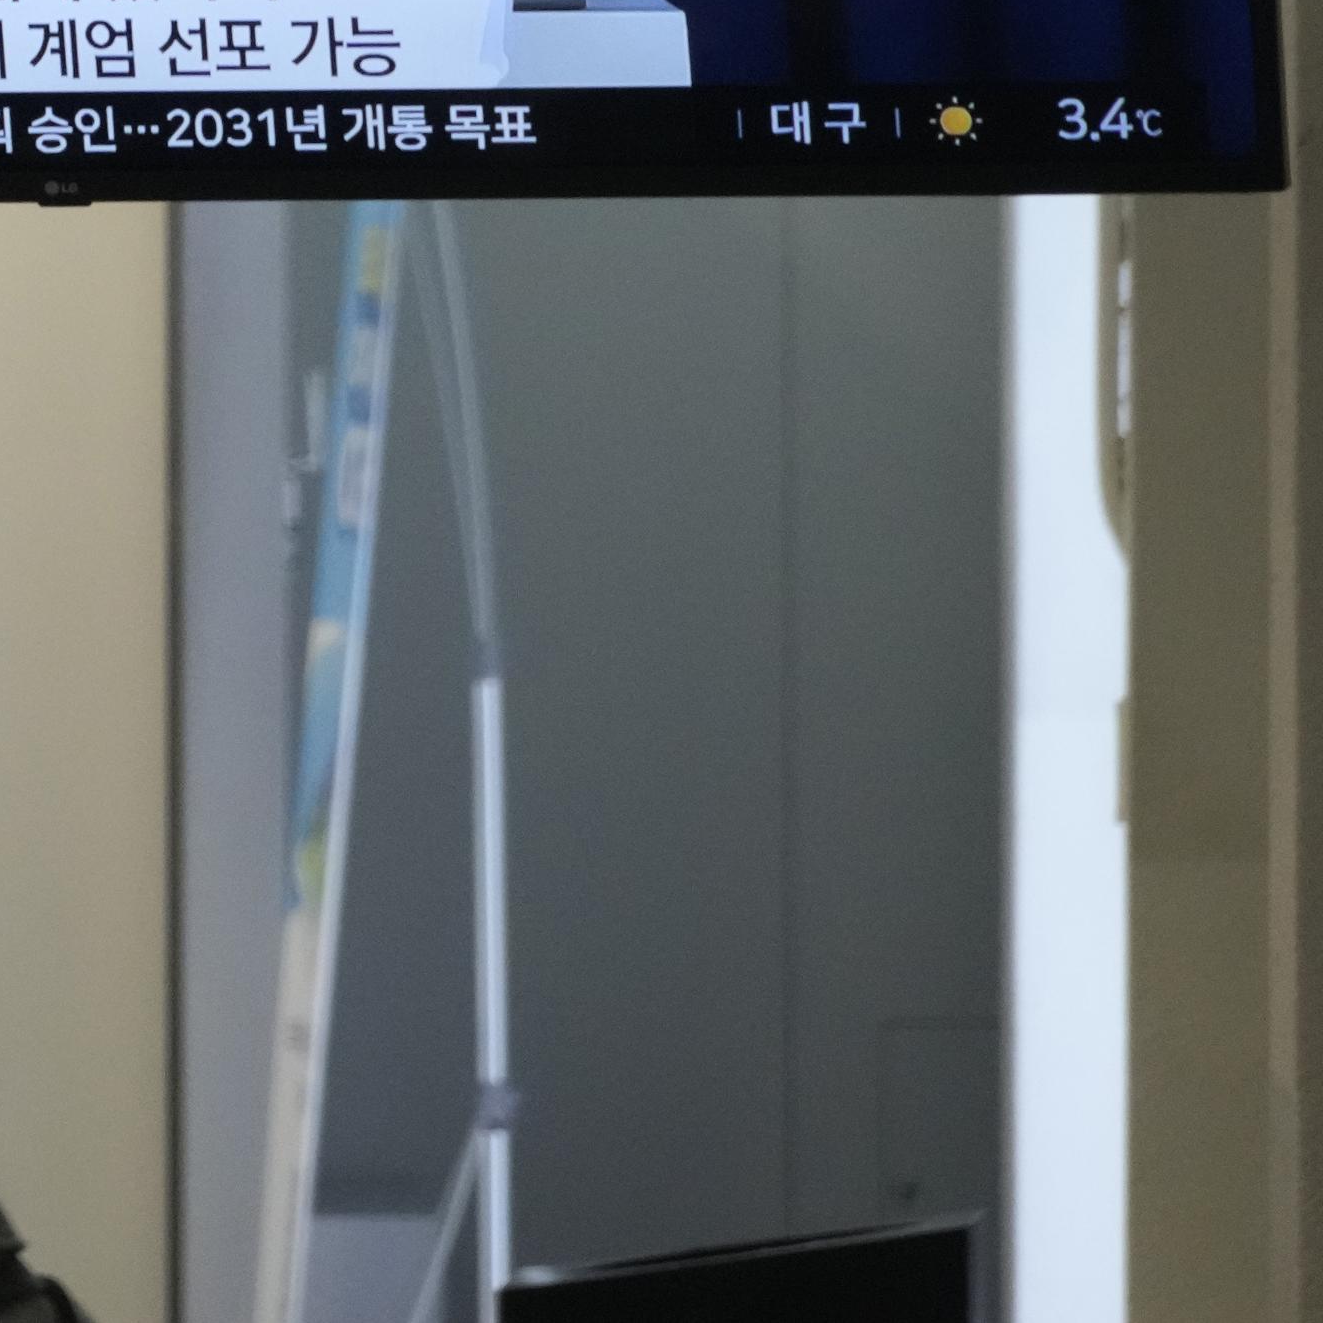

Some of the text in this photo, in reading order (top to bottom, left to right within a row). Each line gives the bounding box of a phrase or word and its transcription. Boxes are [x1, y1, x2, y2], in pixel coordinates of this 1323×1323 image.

[28, 19, 135, 78] 계엄
[159, 18, 270, 76] 선포
[291, 17, 400, 76] 가능
[342, 104, 433, 150] 개통
[445, 105, 537, 150] 목표
[771, 101, 866, 144] 대구
[61, 183, 78, 193] LG
